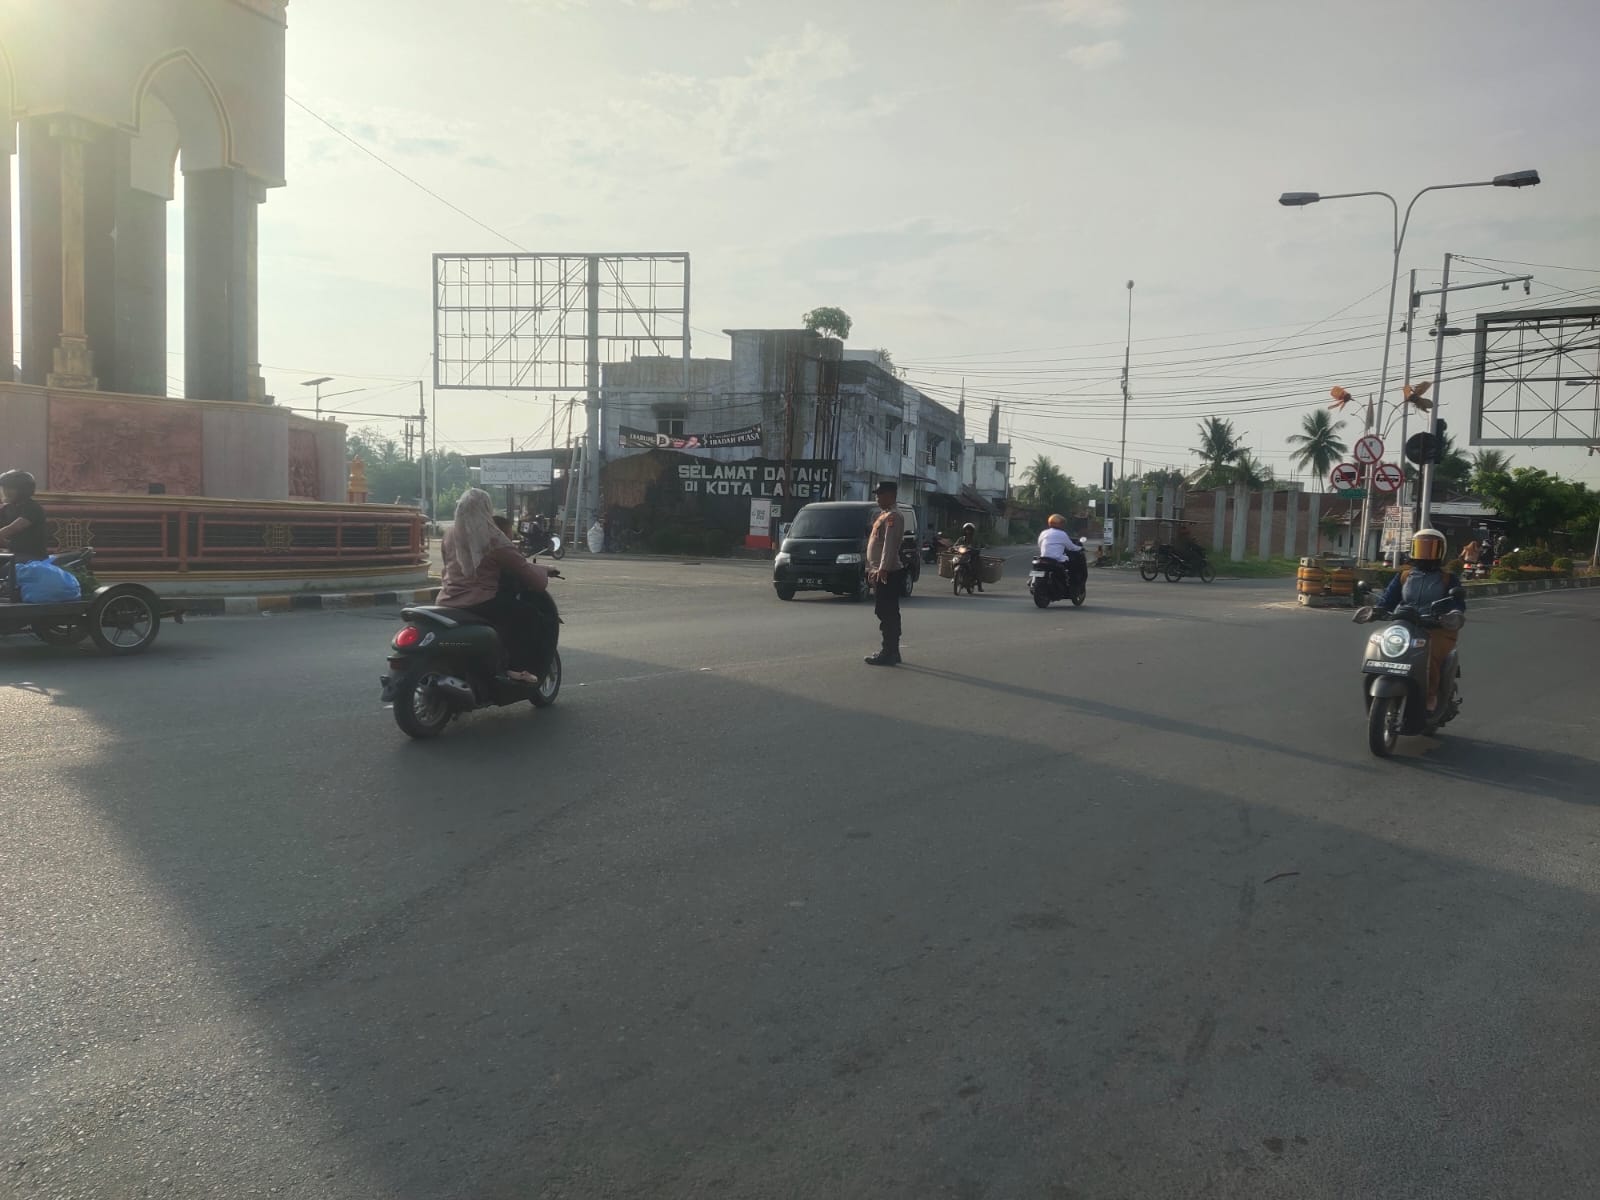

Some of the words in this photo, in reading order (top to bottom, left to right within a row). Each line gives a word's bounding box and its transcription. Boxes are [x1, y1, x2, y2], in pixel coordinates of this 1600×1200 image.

[737, 432, 760, 443] PUASA
[678, 464, 758, 480] SELAMAT
[684, 480, 698, 492] DI
[706, 481, 753, 496] KOTA
